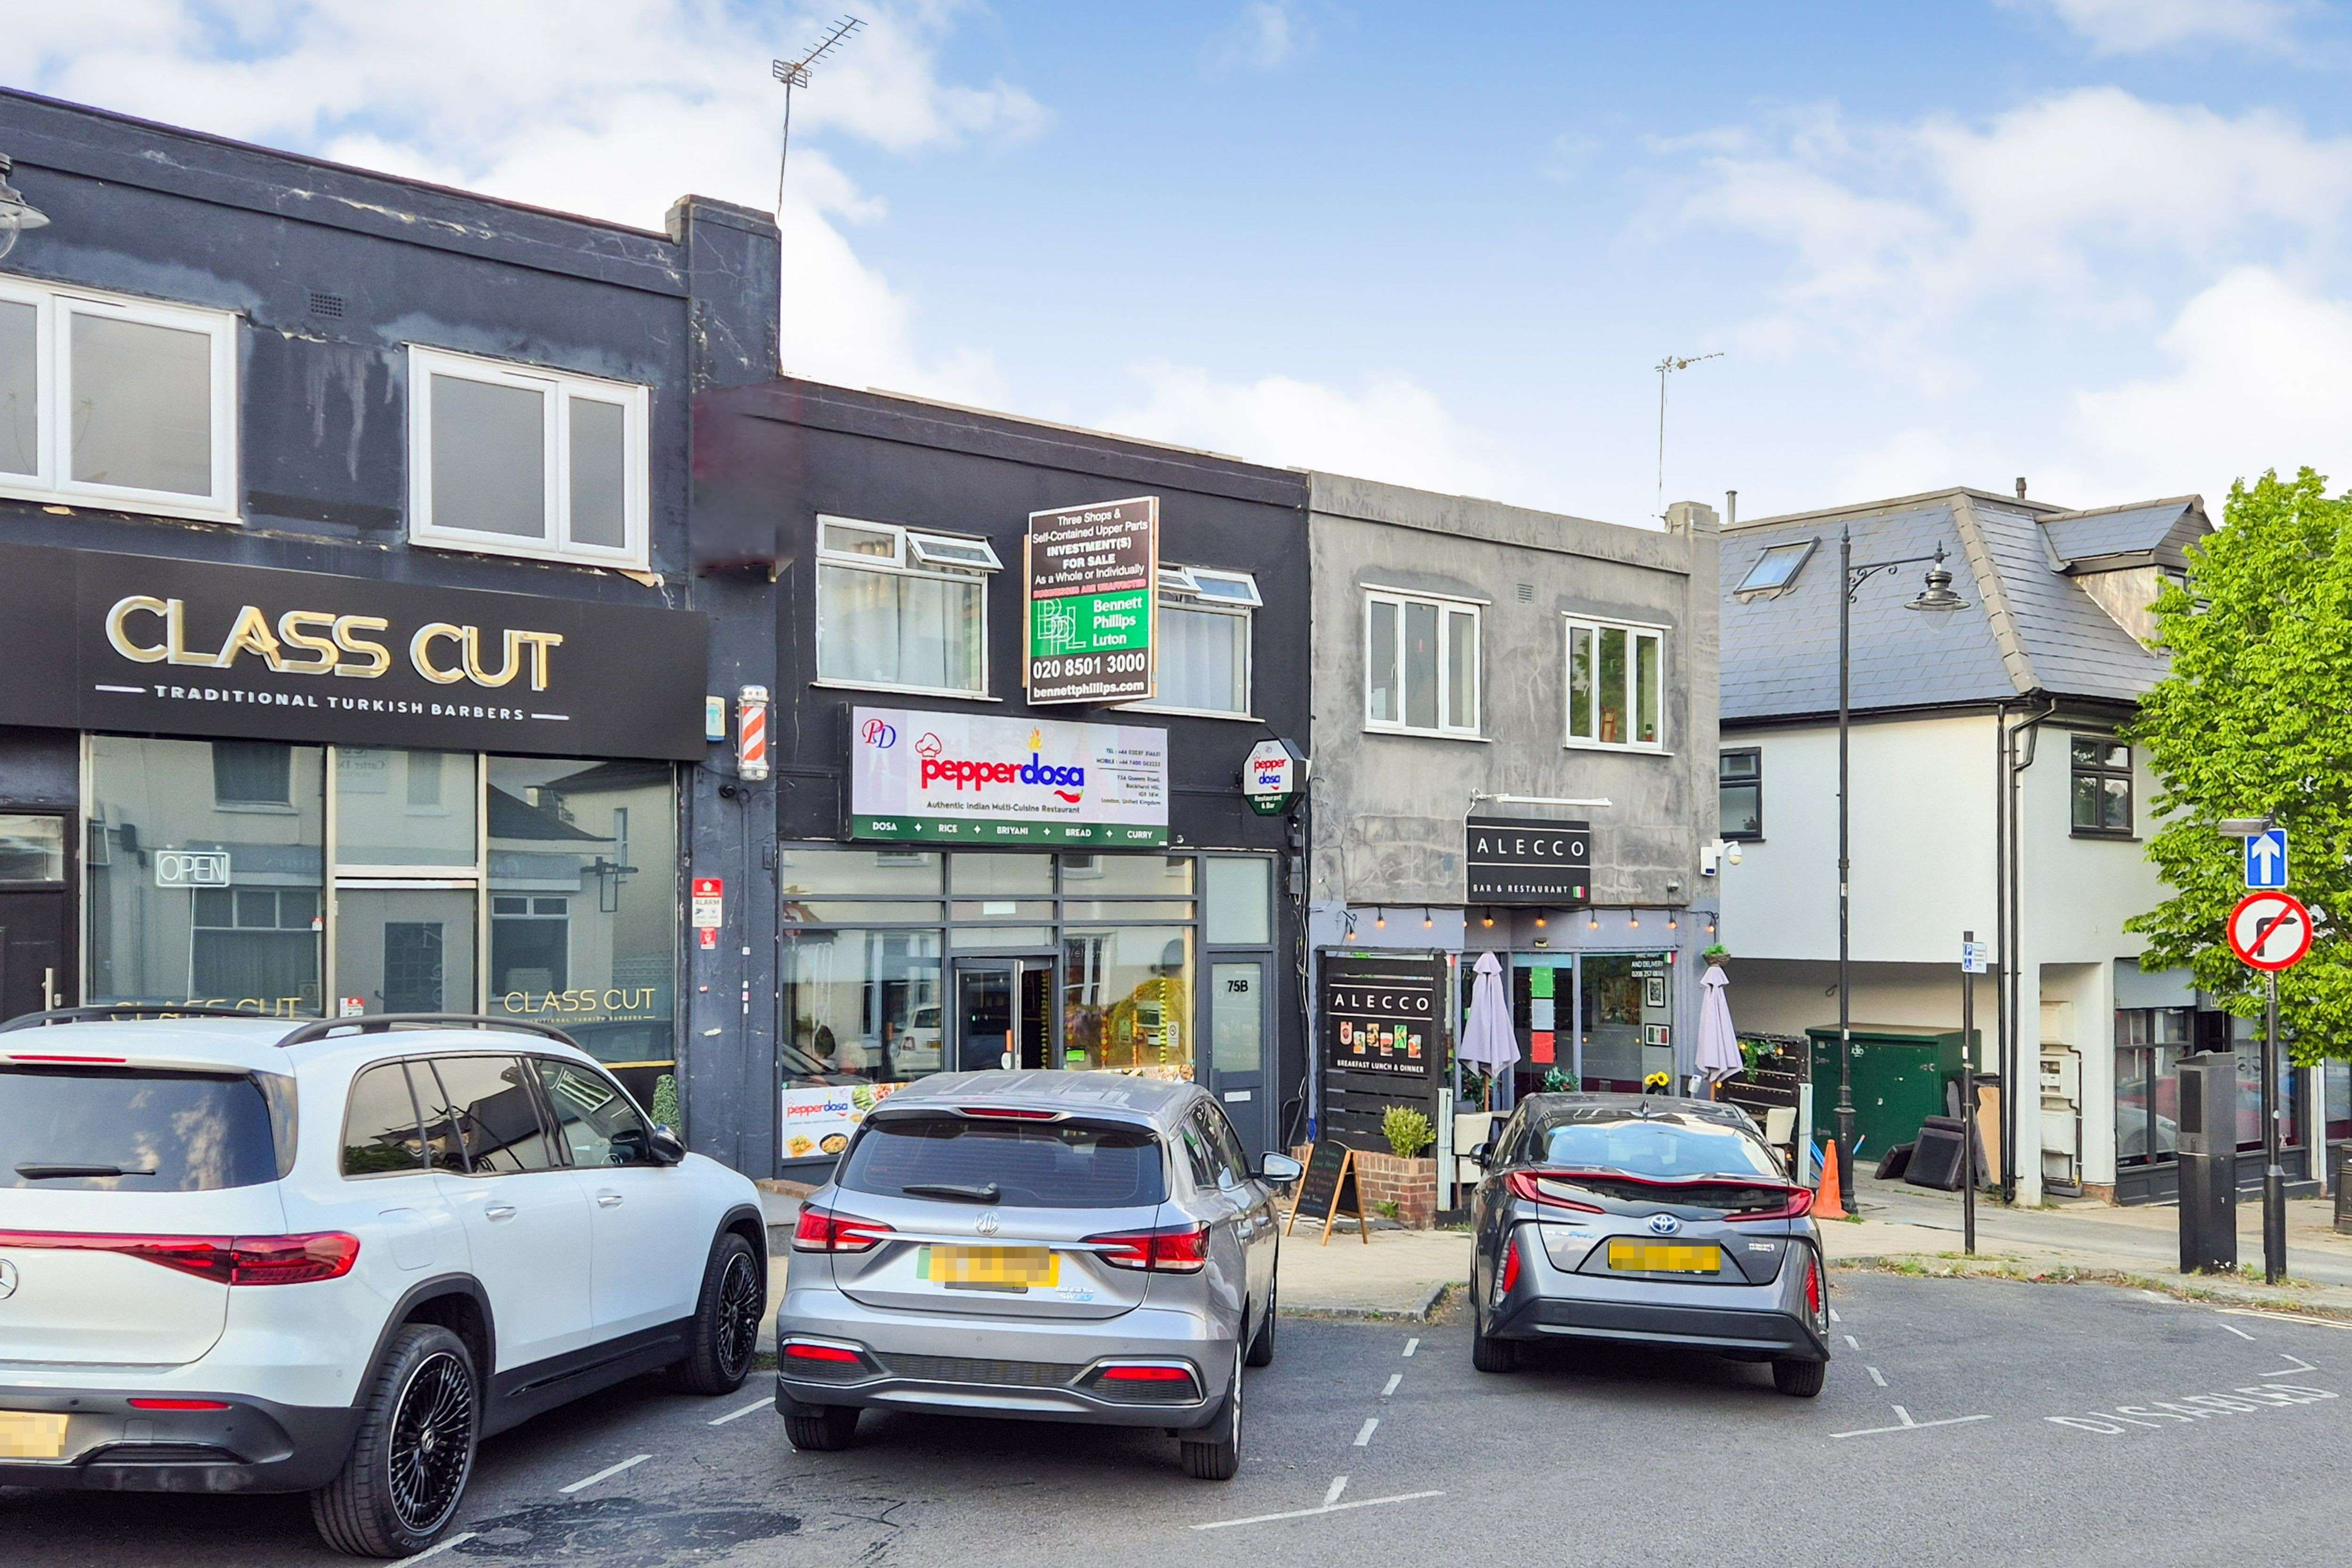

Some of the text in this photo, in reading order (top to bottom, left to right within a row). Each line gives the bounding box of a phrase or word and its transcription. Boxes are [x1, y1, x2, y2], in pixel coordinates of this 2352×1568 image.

[1057, 508, 1121, 526] Three Shops &
[1033, 520, 1148, 543] Self-Contained Upper Parts
[1047, 537, 1132, 557] INVESTMENT(S)
[1063, 553, 1116, 570] FOR SALE
[1035, 574, 1046, 585] As
[1055, 571, 1082, 583] Whole
[1084, 571, 1094, 580] or
[1096, 564, 1144, 578] Individually
[1093, 596, 1143, 613] Bennett
[1093, 613, 1136, 630] Phillips
[105, 596, 563, 691] CLASS CUT
[1093, 633, 1127, 647] Luton
[1033, 653, 1145, 679] 020 8501 3000
[1033, 681, 1144, 698] bennettphillips.com
[154, 685, 523, 720] TRADITIONAL TURKISH BARBERS
[921, 753, 1084, 791] pepperdosa
[1254, 759, 1287, 773] pepper
[1259, 772, 1280, 784] dosa
[927, 801, 1080, 814] Authentic Indian Multi-Cuisine Restaurant
[872, 821, 897, 831] DOSA
[938, 824, 957, 833] RICE
[997, 826, 1028, 835] BRIYANI
[1065, 828, 1091, 837] BREAD
[1127, 830, 1152, 839] CURRY
[1477, 837, 1584, 857] ALECCO
[160, 856, 224, 882] OPEN
[1473, 884, 1491, 892] BAR
[1508, 884, 1567, 893] RESTAURANT
[1227, 980, 1248, 992] 75B
[504, 988, 656, 1012] CLASS CUT
[1335, 993, 1429, 1011] ALECCO
[1337, 1059, 1370, 1068] BREAKFAST
[787, 1100, 848, 1117] pepperdosa
[975, 1212, 1000, 1234] MG
[2043, 1384, 2339, 1434] DISABLED
